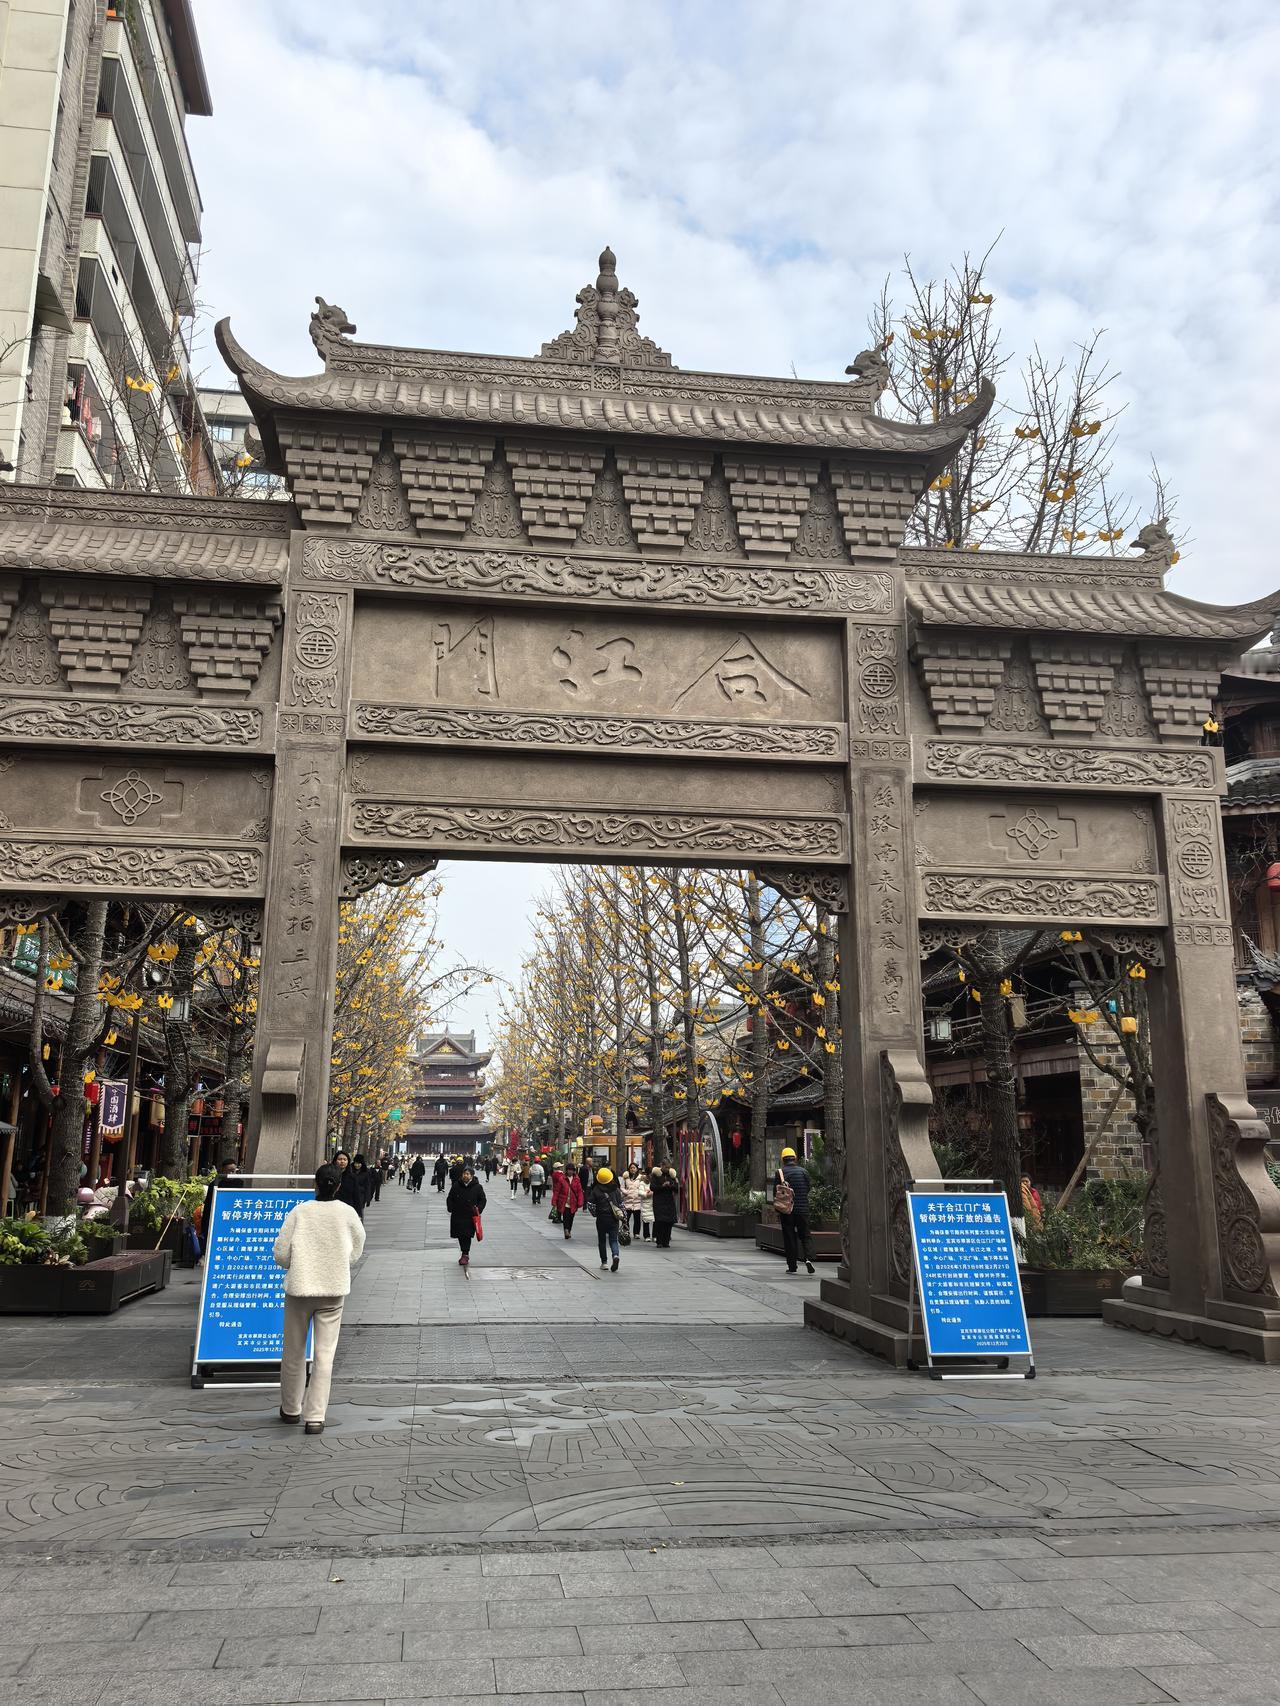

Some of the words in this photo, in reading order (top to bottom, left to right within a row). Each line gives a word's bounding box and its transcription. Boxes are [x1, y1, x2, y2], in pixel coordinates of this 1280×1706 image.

[928, 1203, 991, 1212] 关于合江门广场
[919, 1214, 1001, 1223] 暂停对外开放的通告
